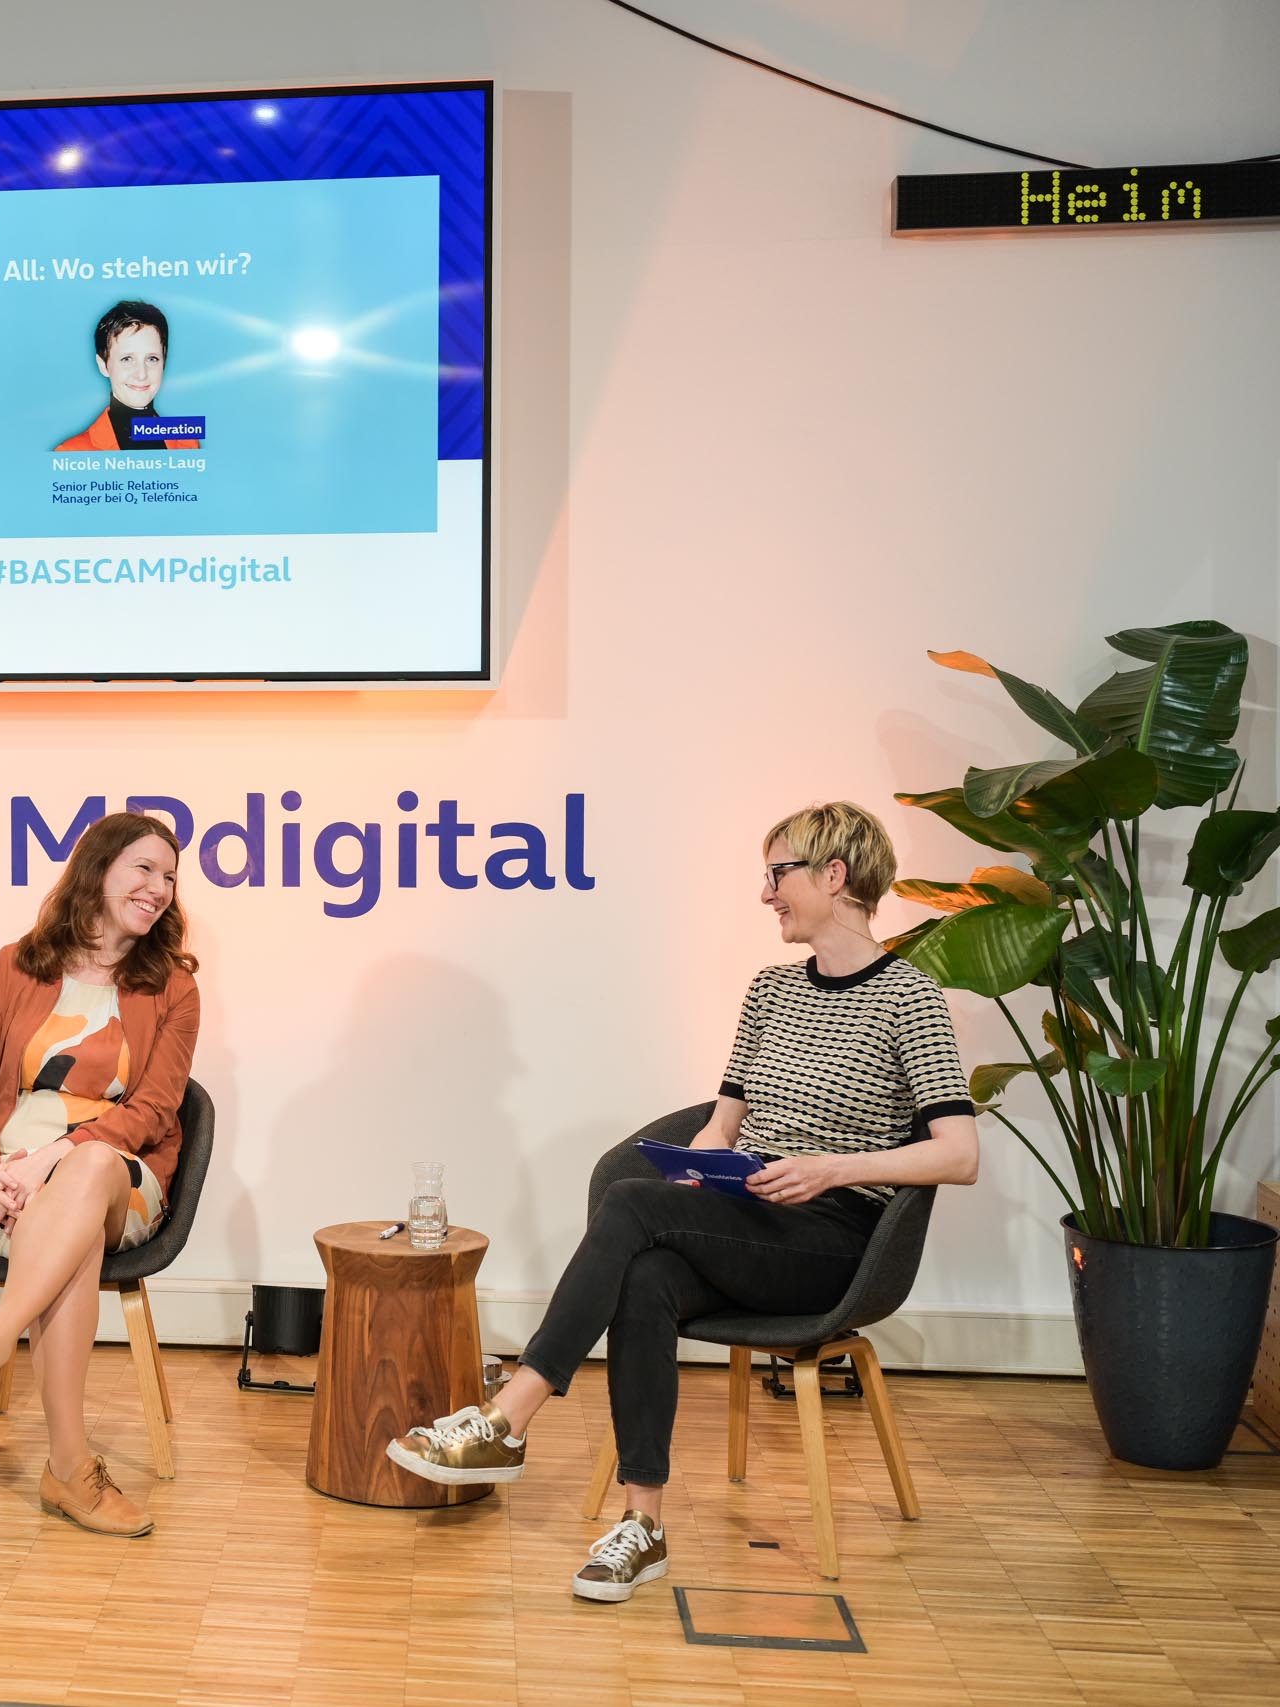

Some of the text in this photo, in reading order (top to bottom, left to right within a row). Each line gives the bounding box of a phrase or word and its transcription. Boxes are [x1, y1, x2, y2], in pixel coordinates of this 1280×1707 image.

[1021, 168, 1201, 225] Heim
[4, 258, 44, 282] All:
[52, 258, 94, 280] Wo
[101, 256, 188, 279] stehen
[196, 252, 251, 276] wir?
[134, 424, 202, 435] Moderation
[53, 456, 206, 472] Nicole Nehaus-Laug
[53, 480, 179, 491] Senior Public Relations
[53, 494, 102, 505] Manager
[105, 493, 121, 502] bei
[142, 492, 198, 502] Telefónica
